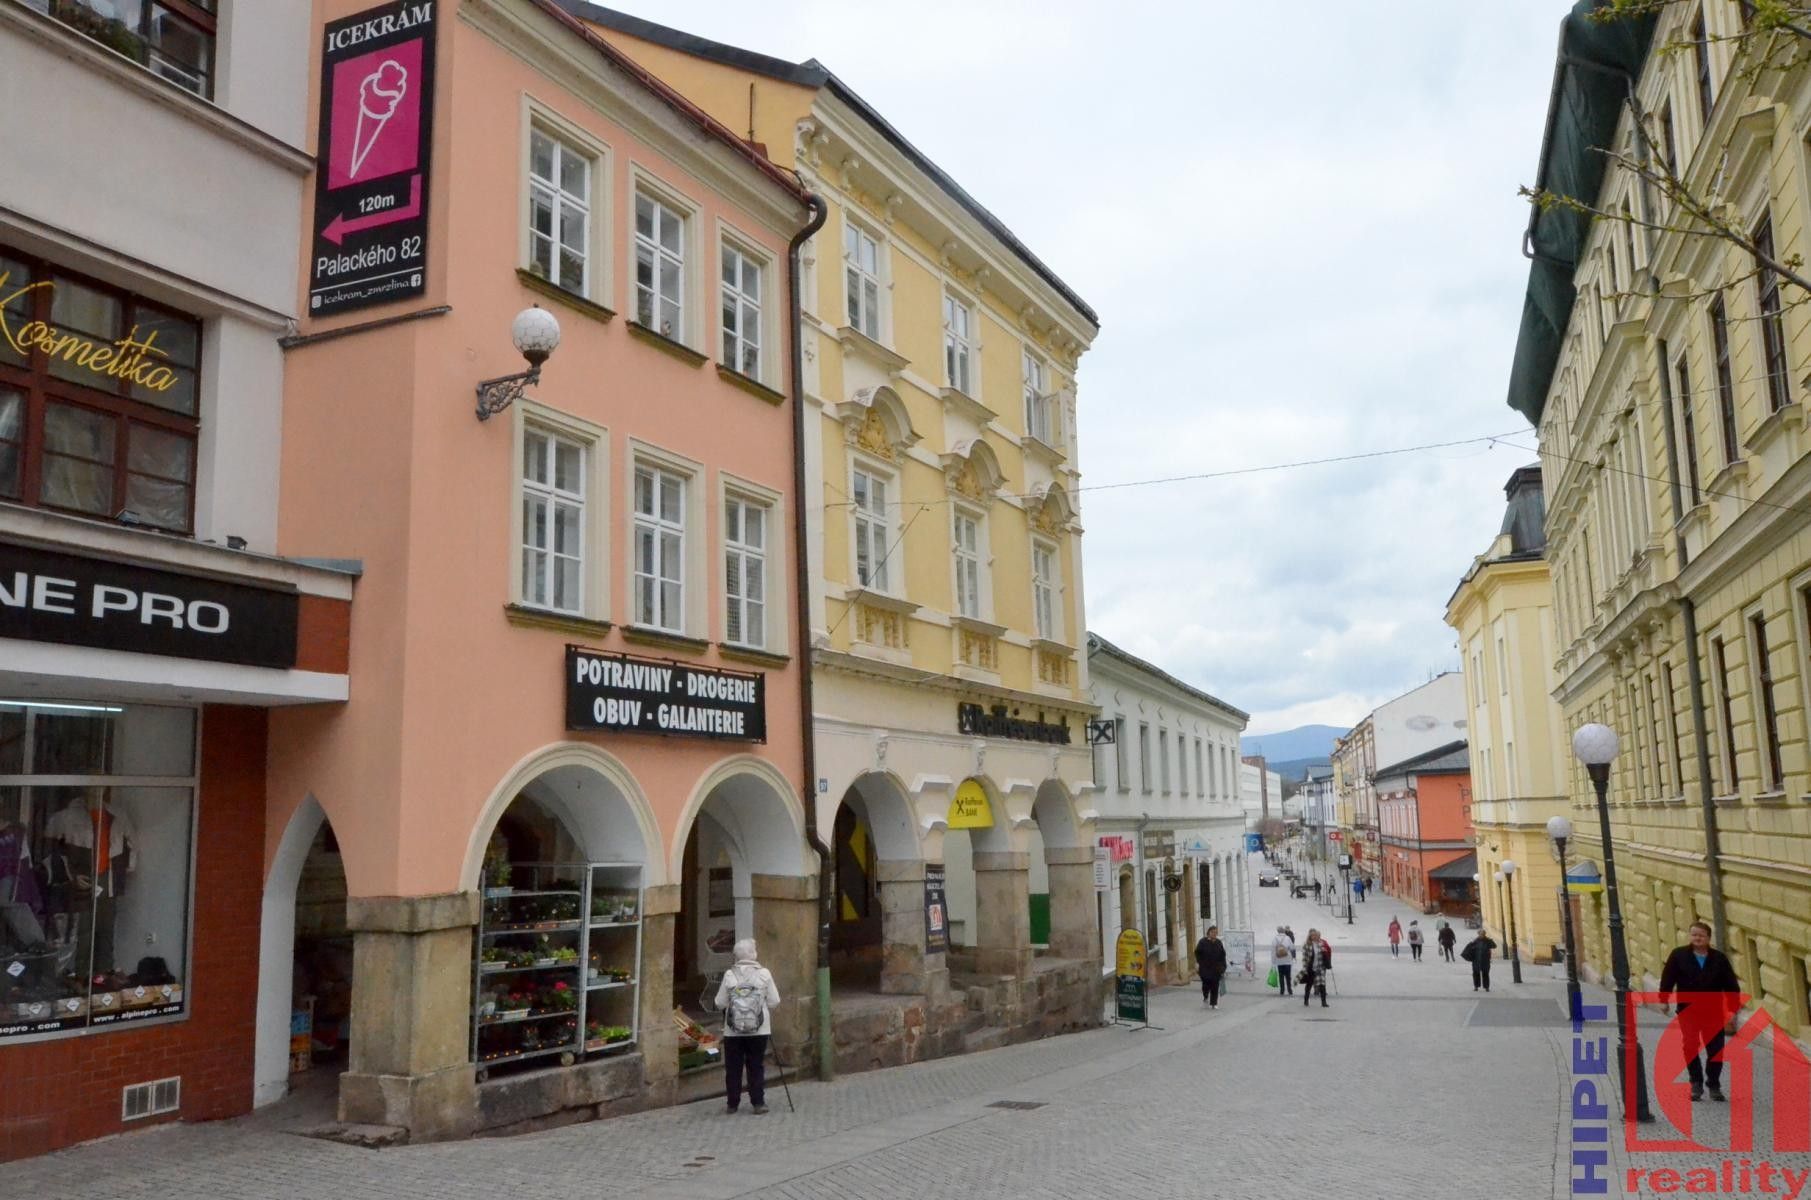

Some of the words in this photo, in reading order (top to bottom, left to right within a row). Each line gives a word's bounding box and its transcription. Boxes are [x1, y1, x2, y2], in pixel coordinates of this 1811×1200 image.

[326, 2, 433, 52] ICEKRÁM
[358, 194, 395, 213] 120m
[316, 244, 397, 278] Palackého
[400, 235, 421, 259] 82
[92, 584, 230, 634] PRO
[576, 657, 672, 693] POTRAVINY
[687, 672, 756, 703] DROGERIE
[593, 697, 642, 726] OBUV
[657, 703, 745, 735] GALANTERIE
[38, 1021, 60, 1031] com
